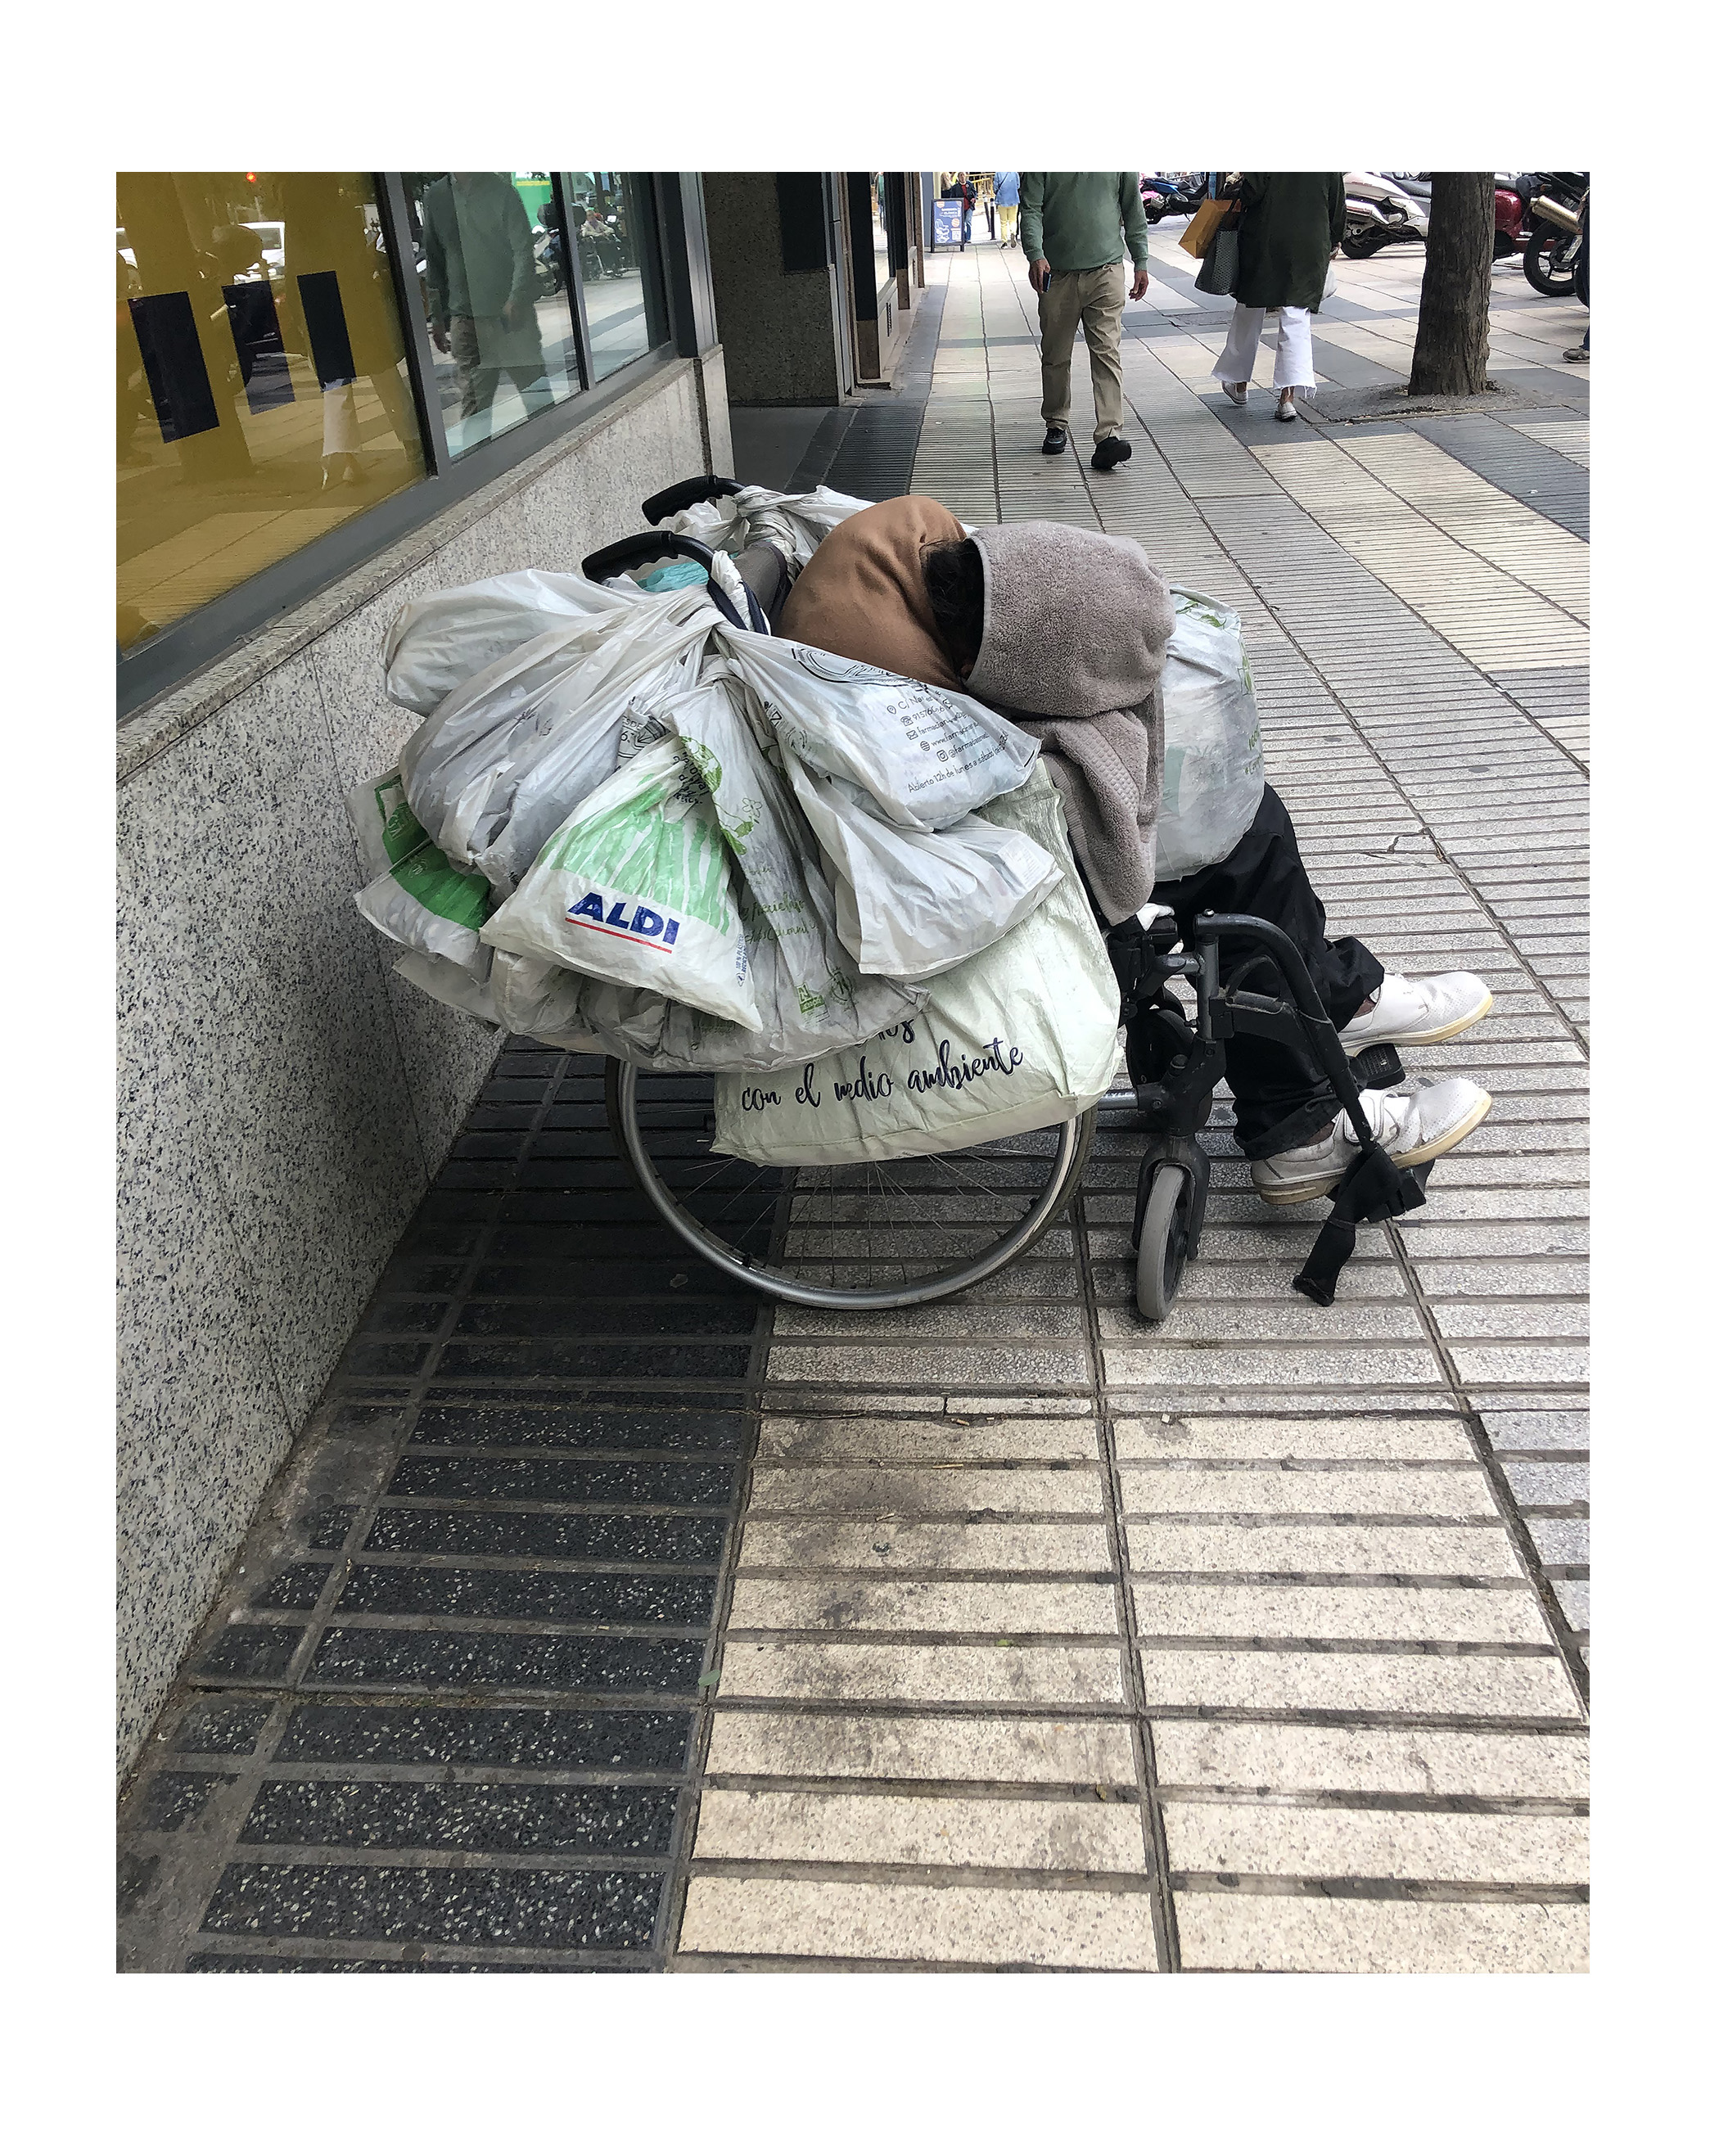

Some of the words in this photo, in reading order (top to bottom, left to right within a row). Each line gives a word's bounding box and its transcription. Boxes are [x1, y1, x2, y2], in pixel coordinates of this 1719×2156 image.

[908, 778, 934, 792] Abierto
[935, 770, 946, 782] 12h
[945, 767, 954, 778] de
[954, 762, 973, 775] lunes
[567, 891, 680, 945] ALDI
[742, 1087, 781, 1111] con
[796, 1062, 821, 1107] el
[834, 1055, 894, 1102] medio
[907, 1037, 1024, 1090] ambiente
